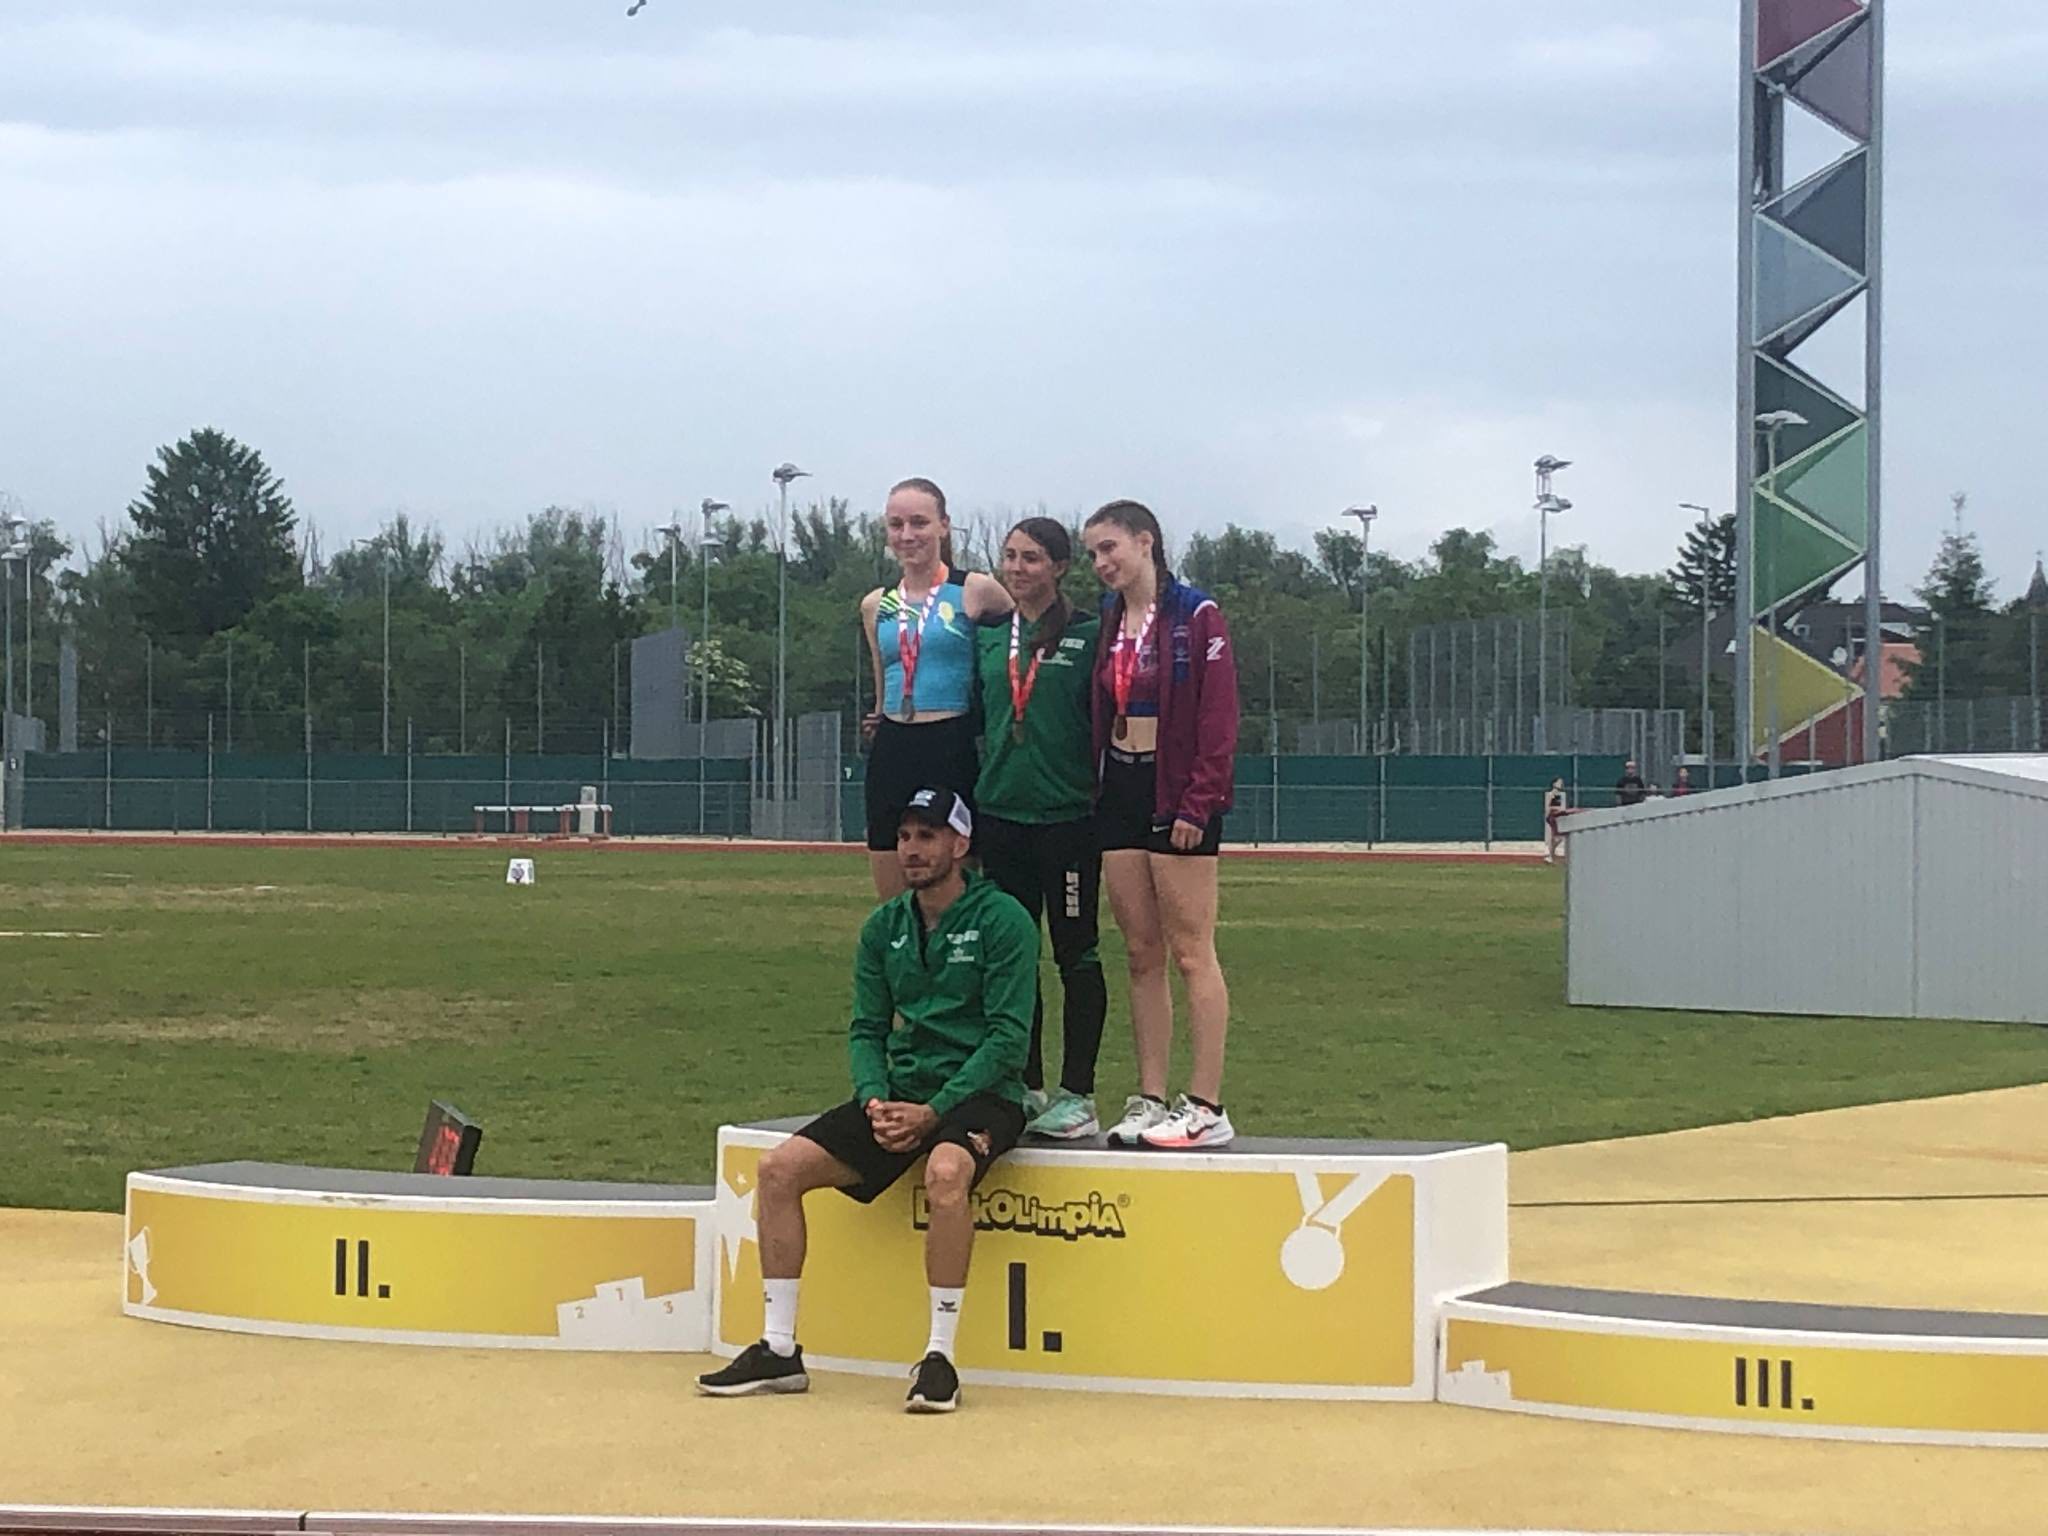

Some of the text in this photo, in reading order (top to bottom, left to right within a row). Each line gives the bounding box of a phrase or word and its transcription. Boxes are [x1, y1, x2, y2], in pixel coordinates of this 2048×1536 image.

[335, 1238, 391, 1299] II.
[575, 1306, 585, 1319] 2
[1735, 1356, 1814, 1410] III.
